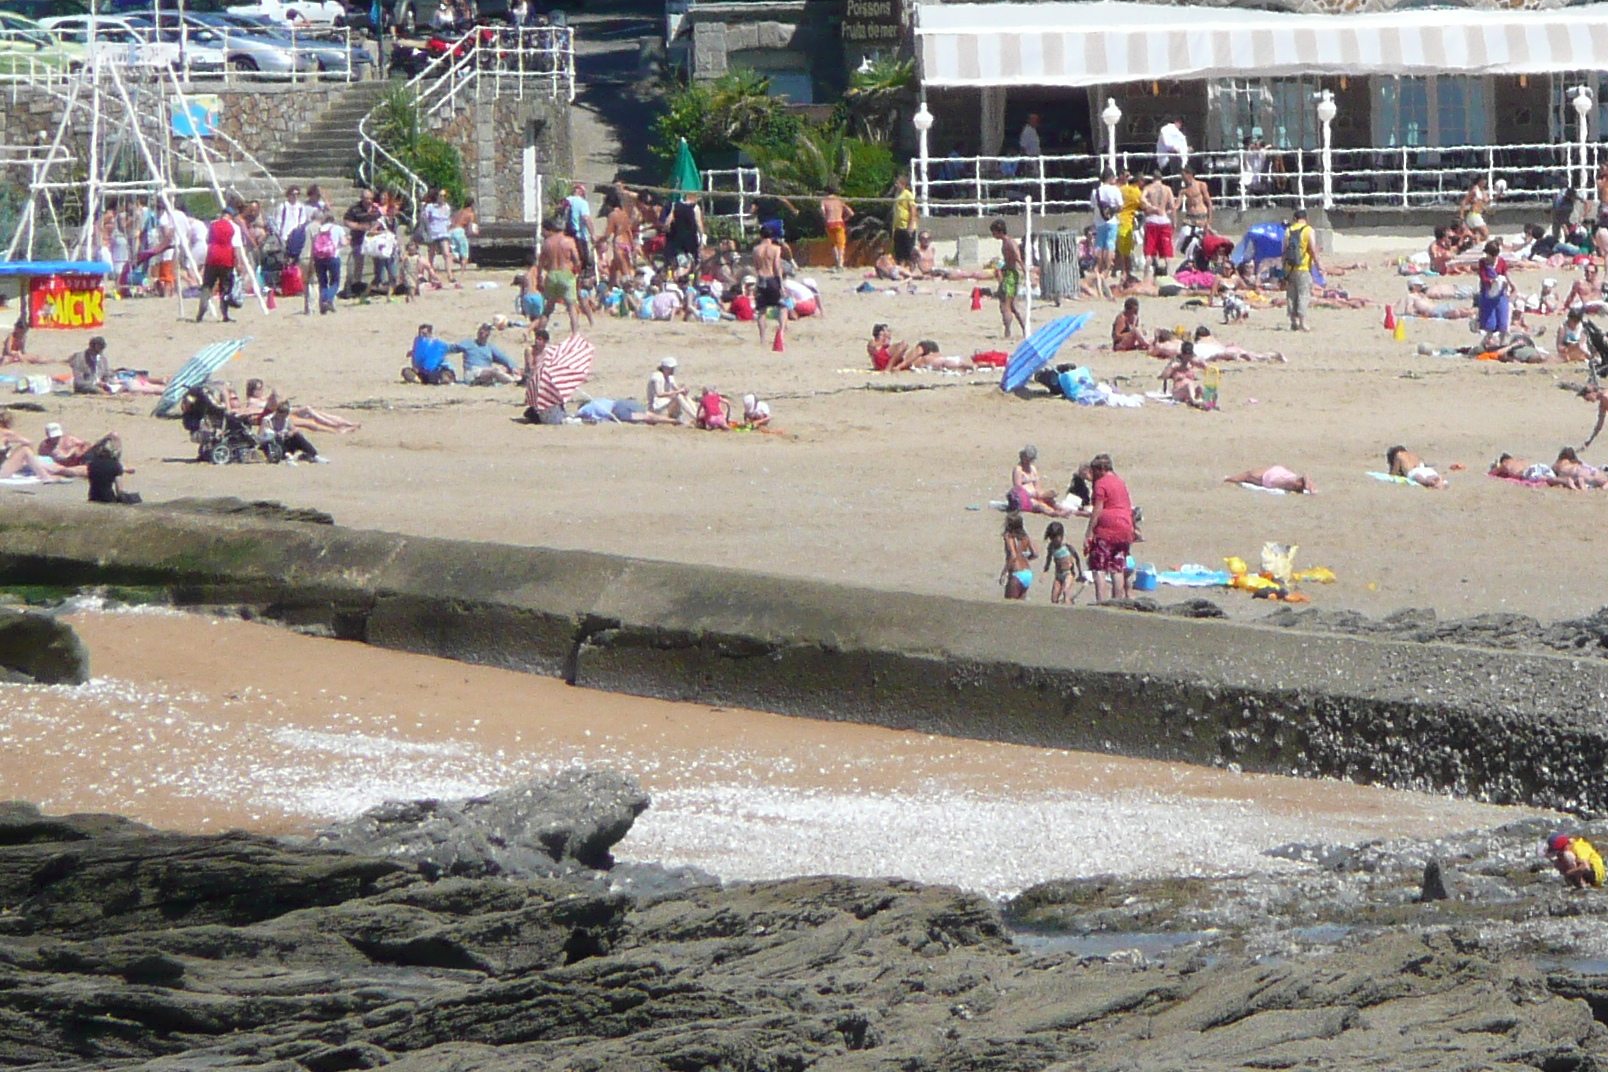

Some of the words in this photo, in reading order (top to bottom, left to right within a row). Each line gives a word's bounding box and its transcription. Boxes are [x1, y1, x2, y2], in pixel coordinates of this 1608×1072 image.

[846, 0, 892, 17] Poissons
[841, 20, 866, 40] Fruits
[880, 24, 898, 38] mer
